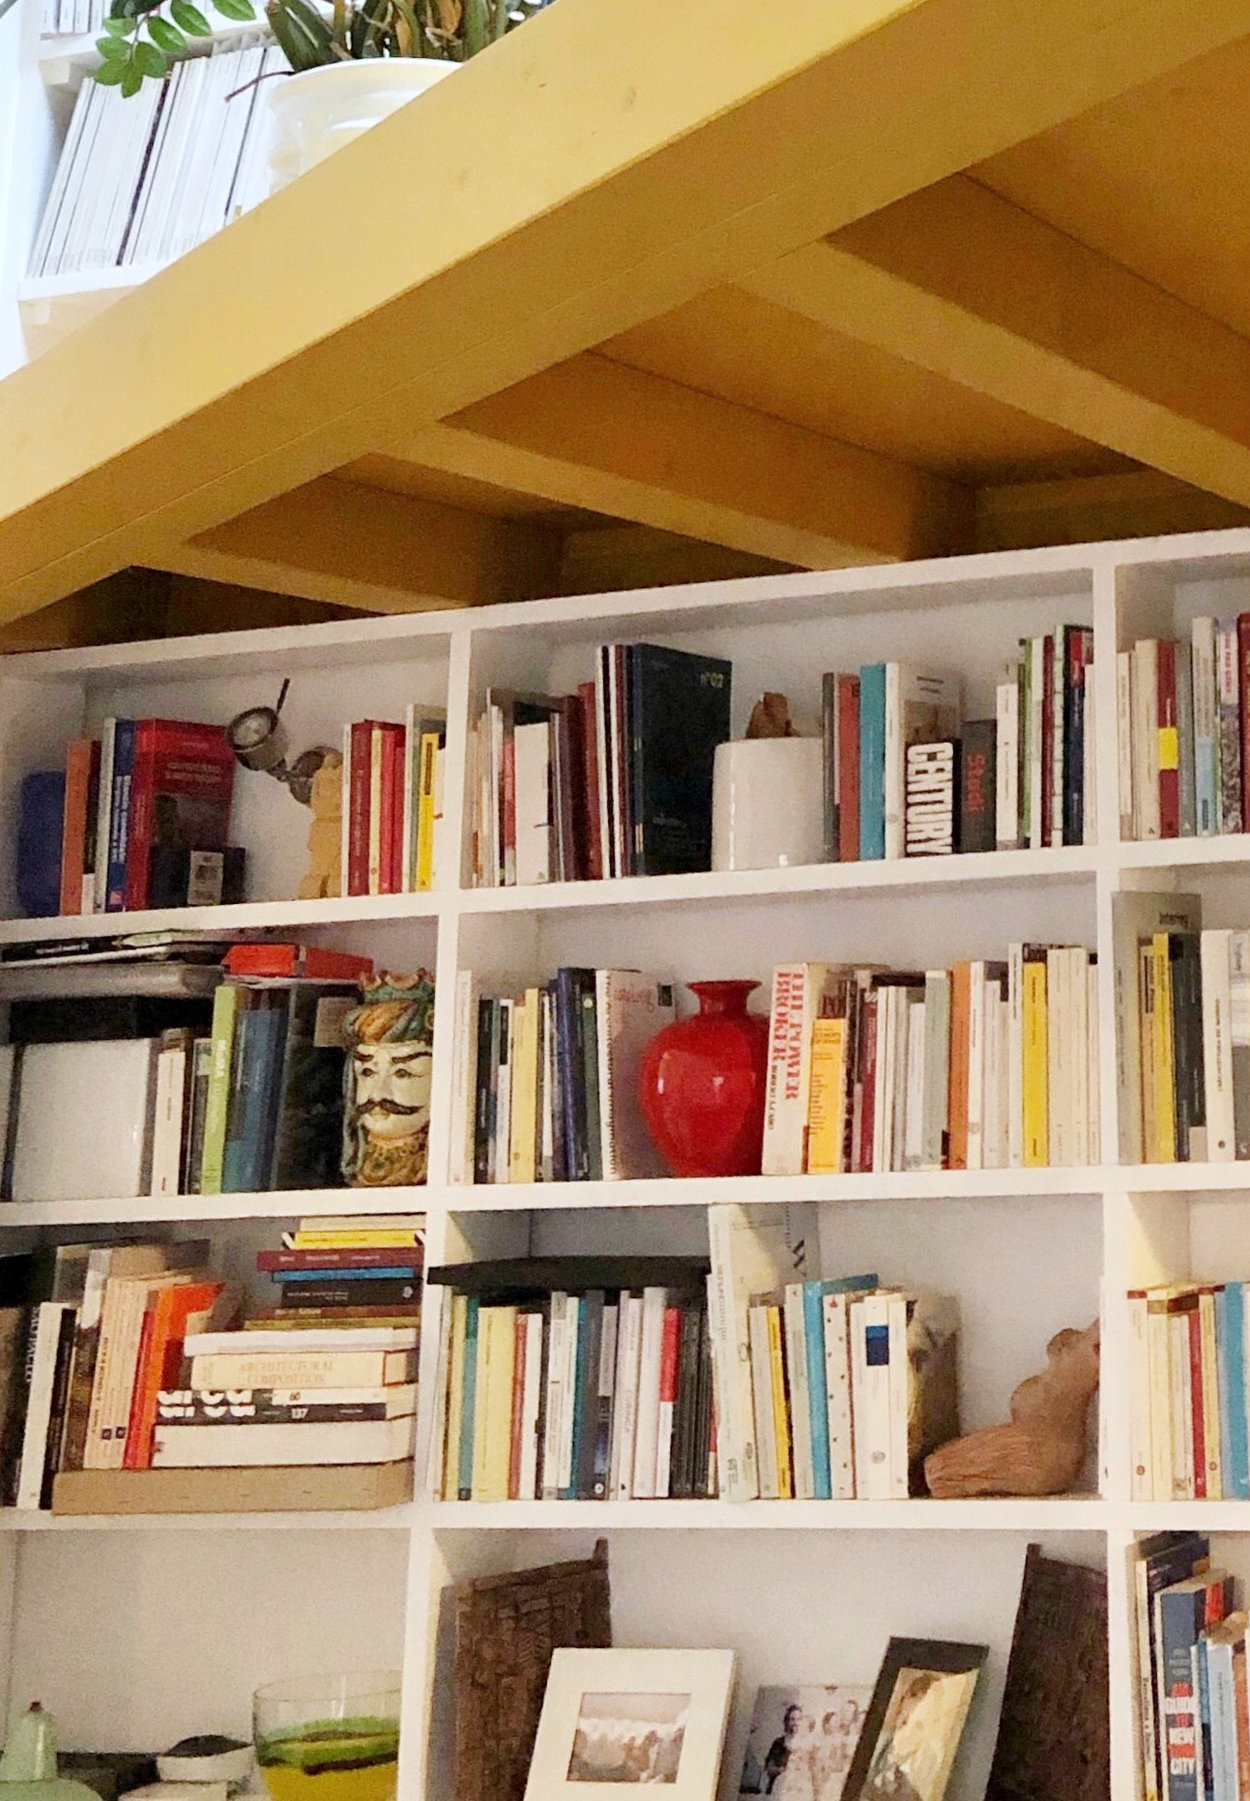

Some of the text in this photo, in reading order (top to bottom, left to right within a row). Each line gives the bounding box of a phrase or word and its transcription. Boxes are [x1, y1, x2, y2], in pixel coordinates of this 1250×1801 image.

[906, 741, 954, 855] CENTURY
[967, 752, 986, 812] Studi
[773, 971, 790, 1062] BROKER
[785, 971, 804, 1100] THE POWER
[239, 1360, 334, 1372] ARCHITECTURAL
[246, 1373, 325, 1384] COMPOSITION
